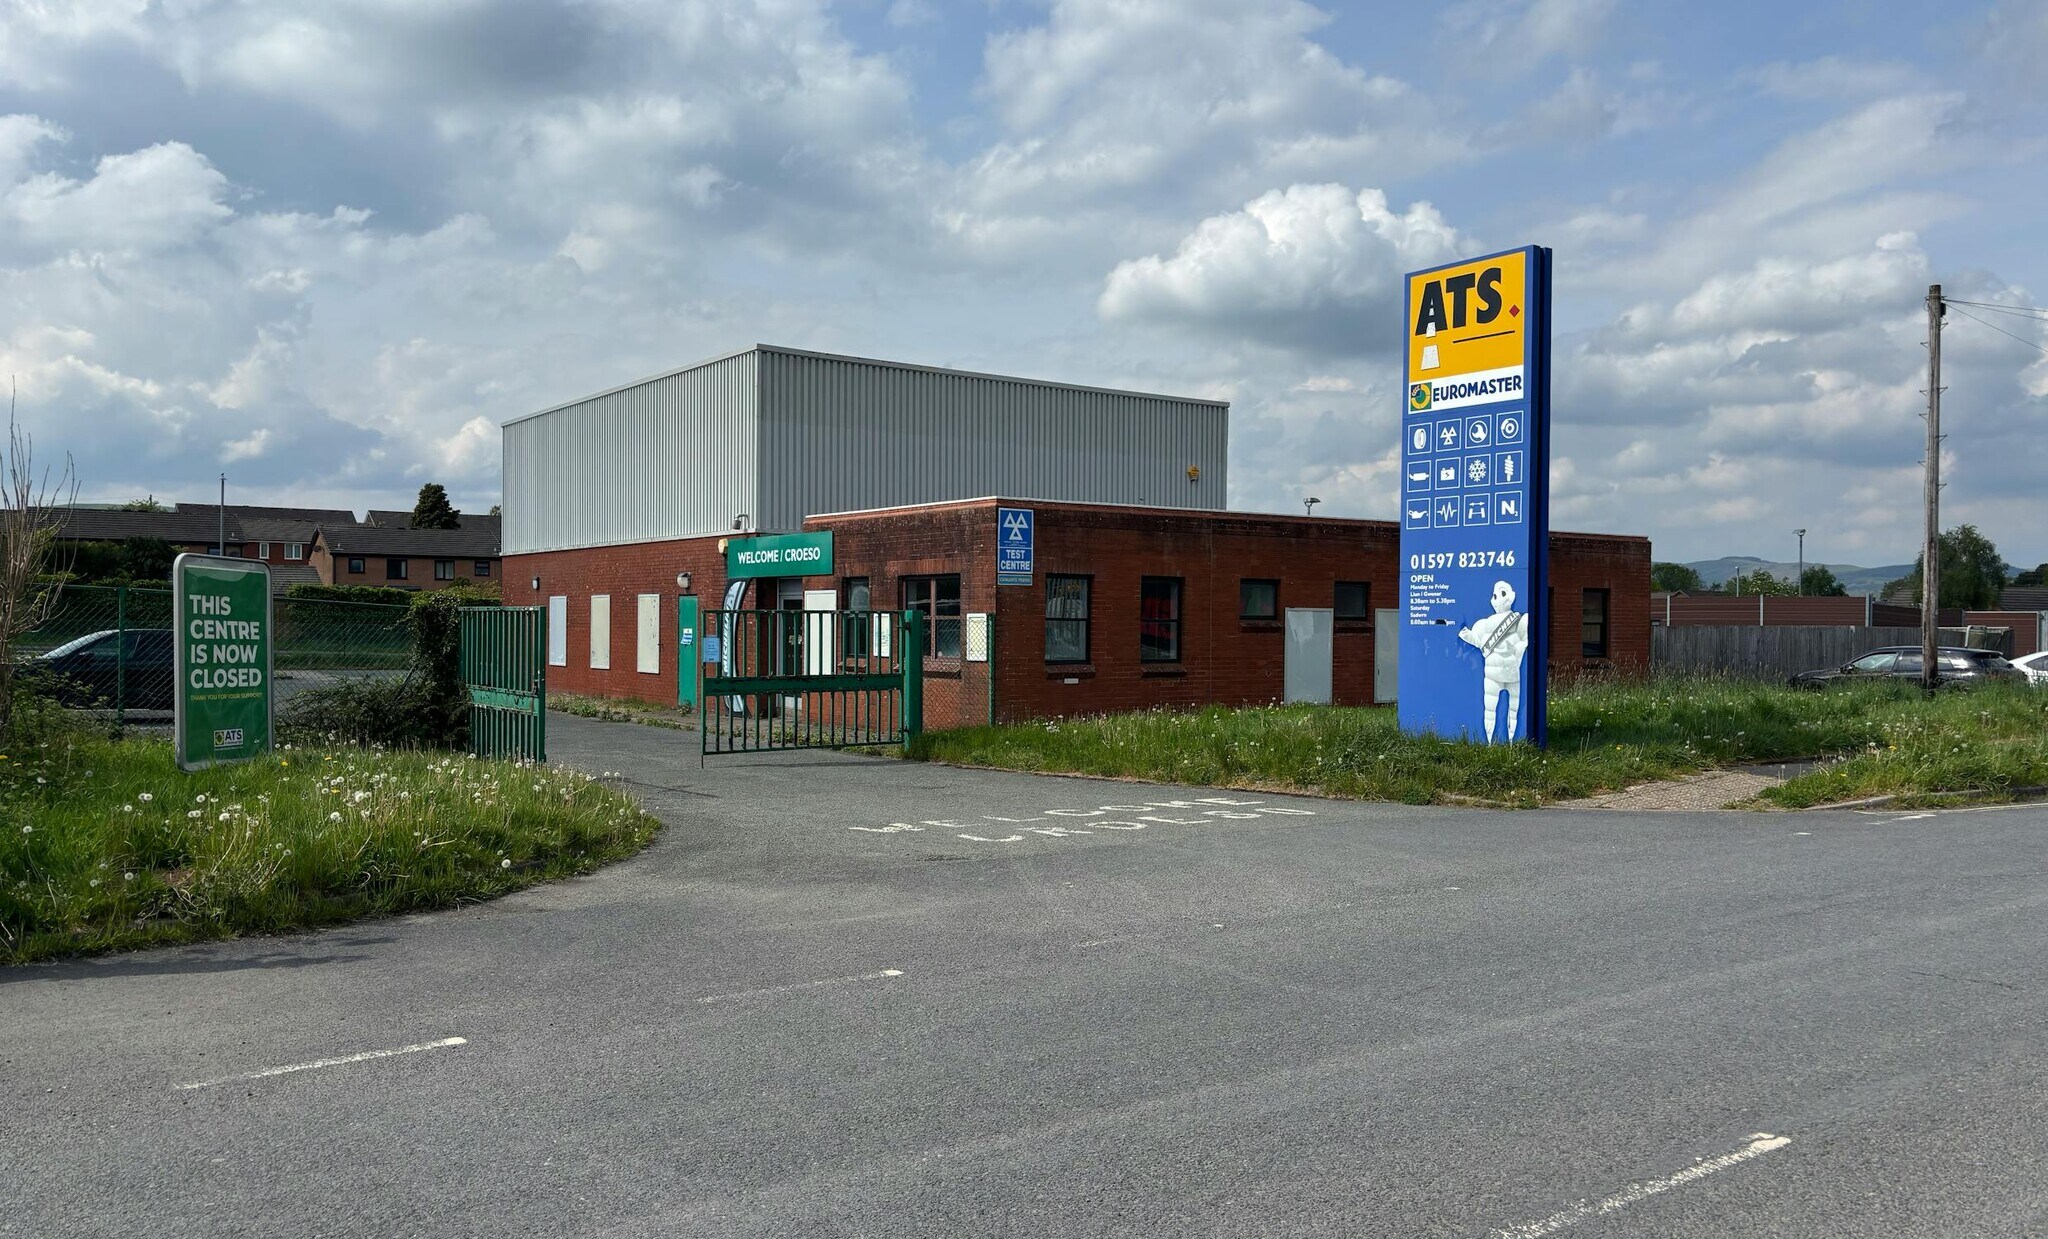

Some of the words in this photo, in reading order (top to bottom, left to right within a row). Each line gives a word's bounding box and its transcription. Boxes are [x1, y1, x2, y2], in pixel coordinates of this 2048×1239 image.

[1433, 375, 1522, 402] EUROMASTER
[737, 549, 779, 564] WELCOME
[784, 547, 820, 562] CROESO
[1006, 550, 1025, 559] TEST
[1410, 553, 1454, 570] 01597
[1459, 550, 1515, 568] 823746
[1000, 560, 1030, 570] CENTRE
[1410, 574, 1434, 583] OPEN
[189, 594, 232, 616] THIS
[190, 619, 260, 640] CENTRE
[190, 644, 208, 664] IS
[213, 644, 258, 664] NOW
[190, 668, 262, 689] CLOSED
[224, 730, 242, 741] ATS
